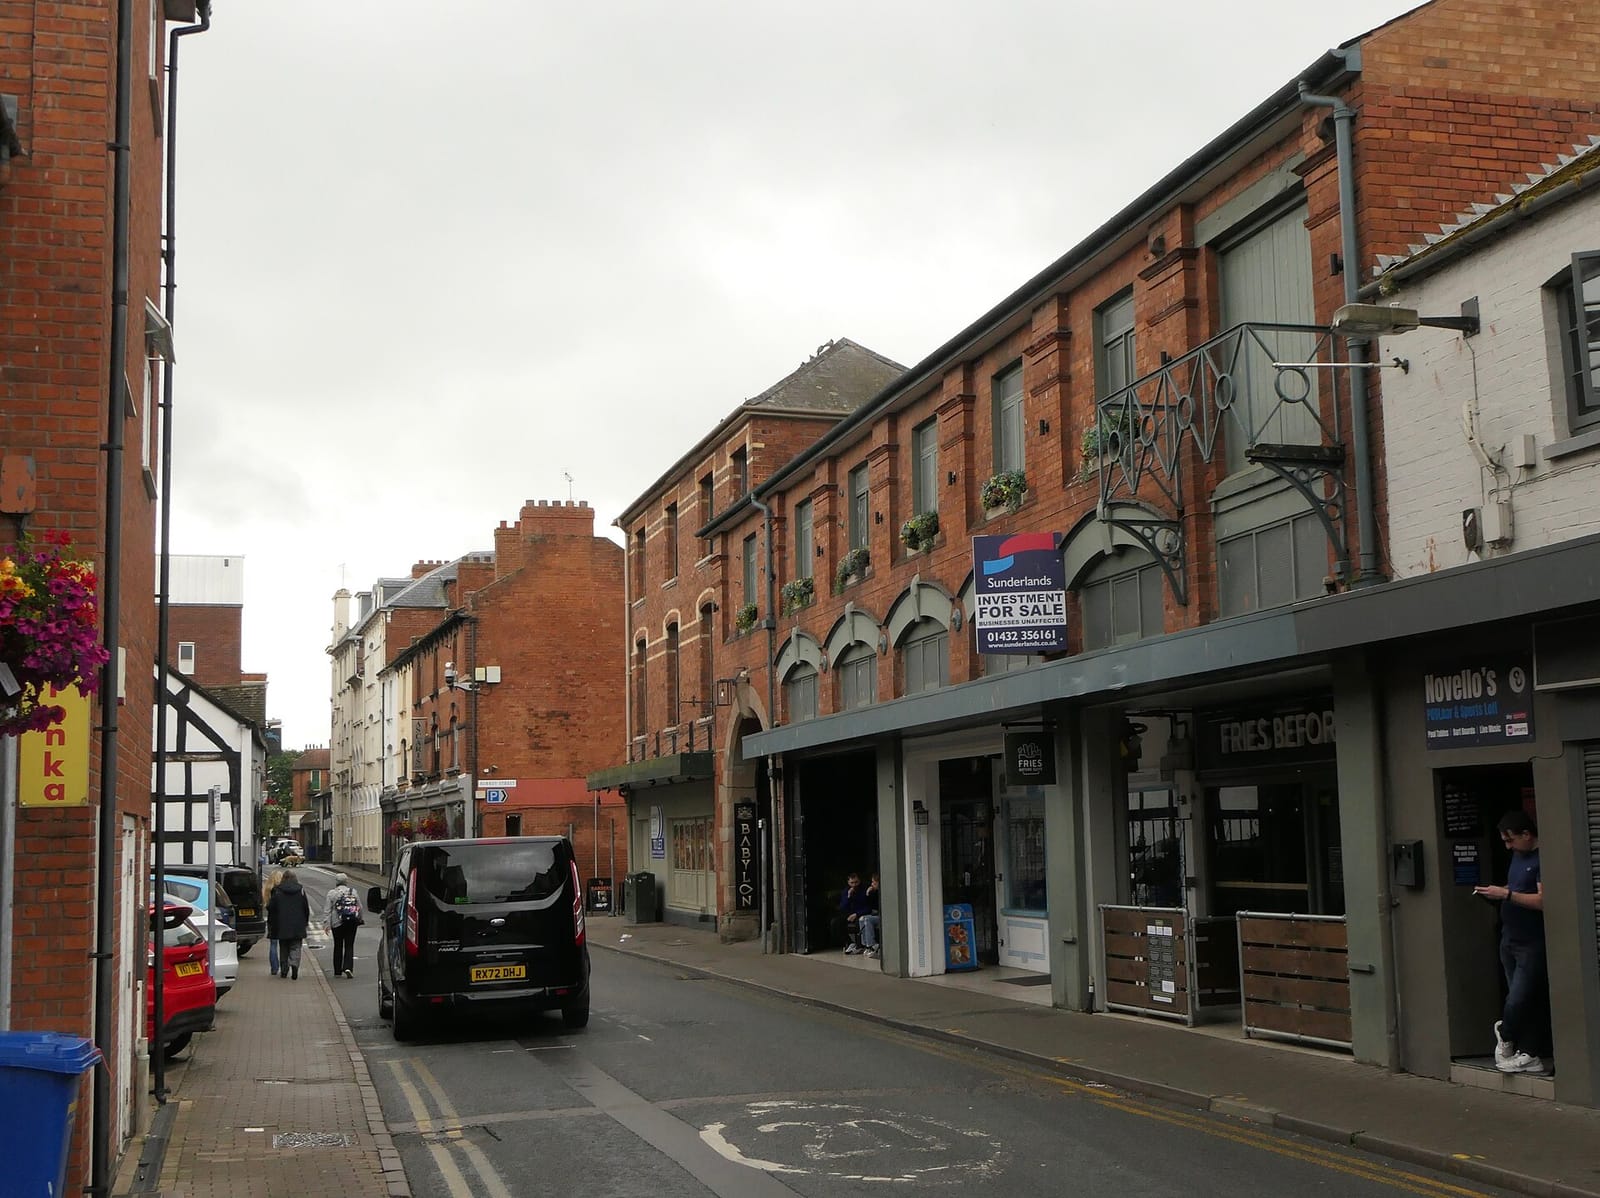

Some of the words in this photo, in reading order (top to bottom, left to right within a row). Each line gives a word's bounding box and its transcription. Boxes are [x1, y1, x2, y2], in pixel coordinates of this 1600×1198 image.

[987, 576, 1052, 588] Sunderlands
[978, 593, 1063, 605] INVESTMENT
[979, 606, 1013, 618] FOR
[1019, 604, 1063, 617] SALE
[987, 632, 1018, 642] 01432
[1020, 630, 1056, 640] 356161
[1424, 666, 1497, 704] Novello's
[1220, 718, 1272, 753] FRIES
[1018, 759, 1042, 768] FRIES
[738, 822, 753, 908] BABYLON
[475, 968, 501, 979] RX72
[503, 966, 522, 977] DHJ
